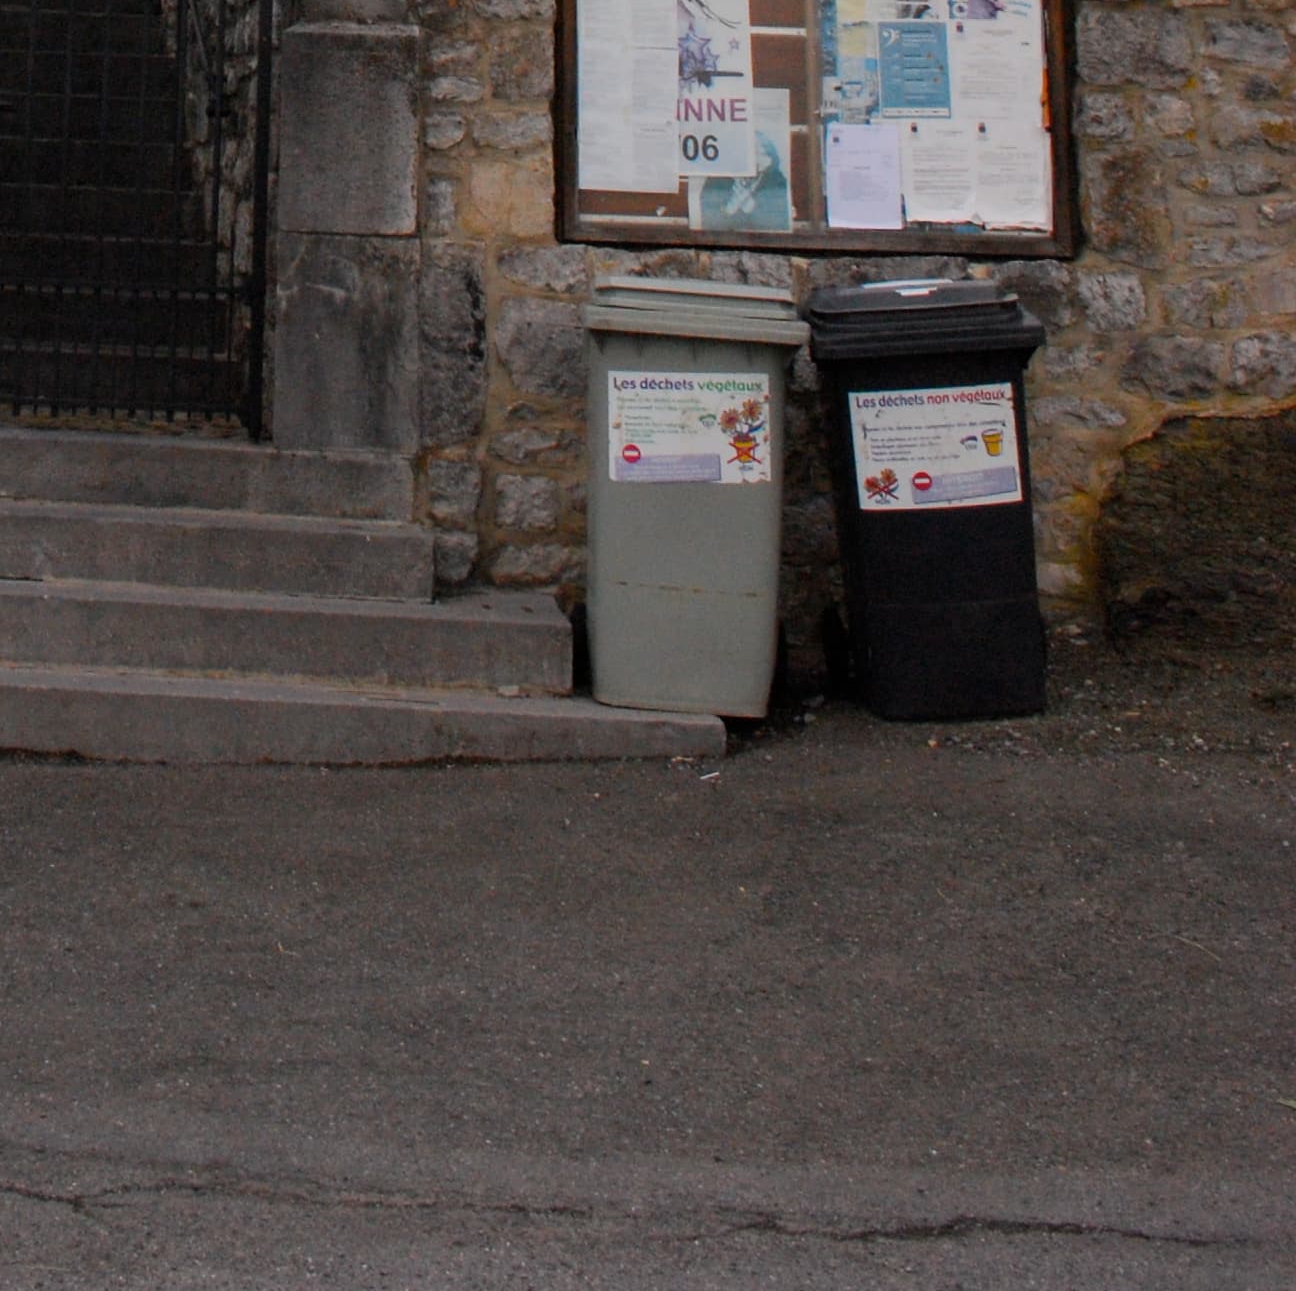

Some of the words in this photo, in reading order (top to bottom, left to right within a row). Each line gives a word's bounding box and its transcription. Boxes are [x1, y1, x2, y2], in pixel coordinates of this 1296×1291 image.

[613, 377, 637, 391] Les
[639, 377, 694, 391] déchets
[697, 378, 763, 392] végétaux
[856, 396, 876, 409] Les
[878, 394, 925, 408] déchets
[927, 393, 950, 404] non
[952, 389, 1006, 403] végétaux
